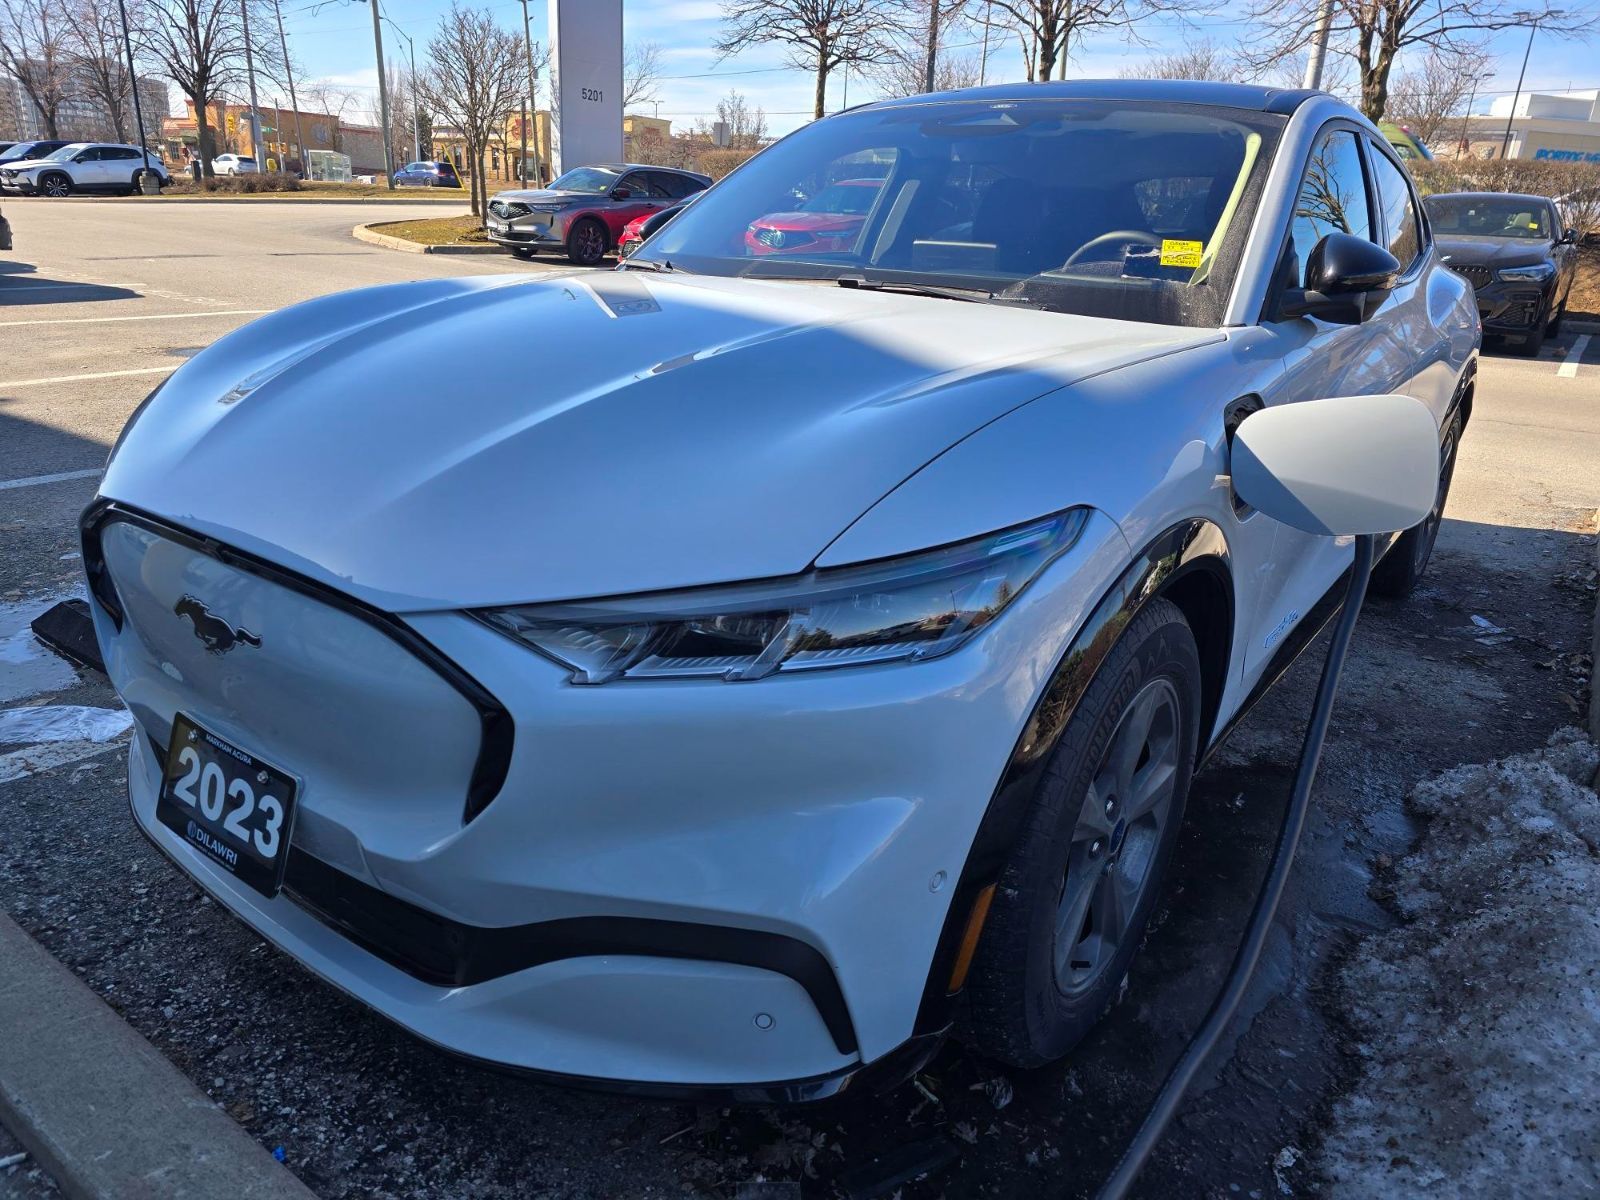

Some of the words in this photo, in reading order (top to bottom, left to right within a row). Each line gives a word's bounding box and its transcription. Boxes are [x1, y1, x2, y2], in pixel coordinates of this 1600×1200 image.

[581, 87, 603, 103] 5201
[206, 733, 232, 755] MARKHAM
[231, 750, 252, 766] ACURA
[173, 746, 284, 859] 2023
[196, 828, 238, 865] DILAWRI
